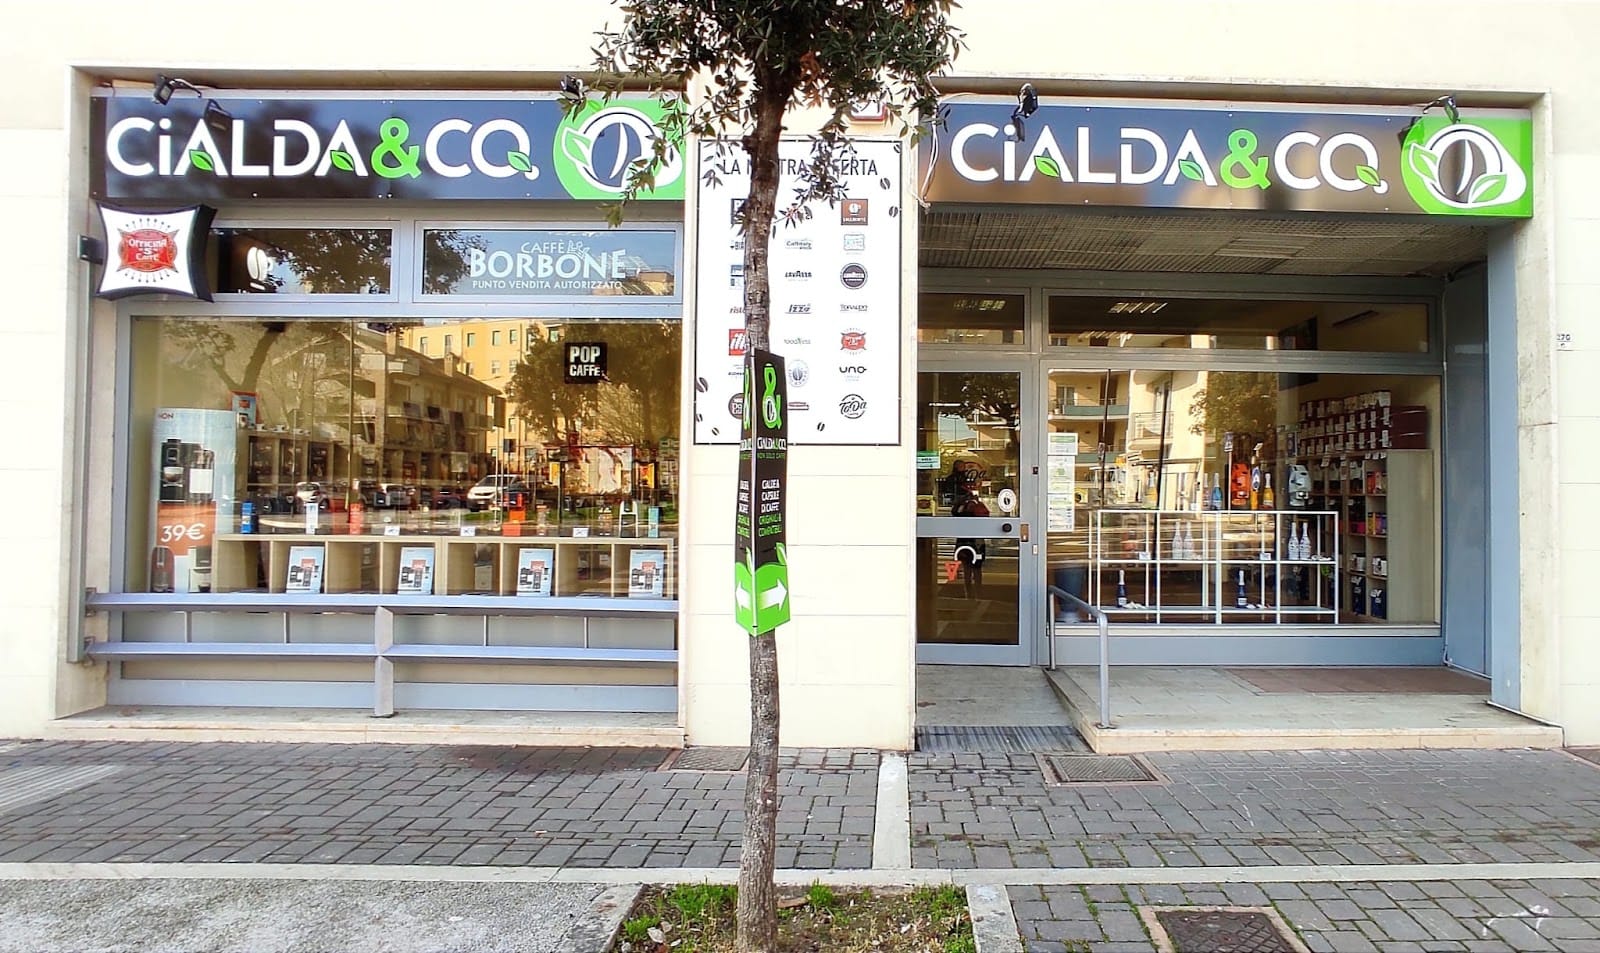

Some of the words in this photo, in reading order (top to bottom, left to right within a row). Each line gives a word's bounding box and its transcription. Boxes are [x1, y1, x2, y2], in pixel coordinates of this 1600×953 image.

[722, 159, 741, 175] LA
[470, 248, 626, 279] BORBONE
[472, 280, 506, 289] PUNTO
[508, 280, 551, 289] VENDITA
[554, 280, 623, 289] AUTORIZZATO
[570, 346, 600, 363] POP
[160, 523, 206, 543] 39€
